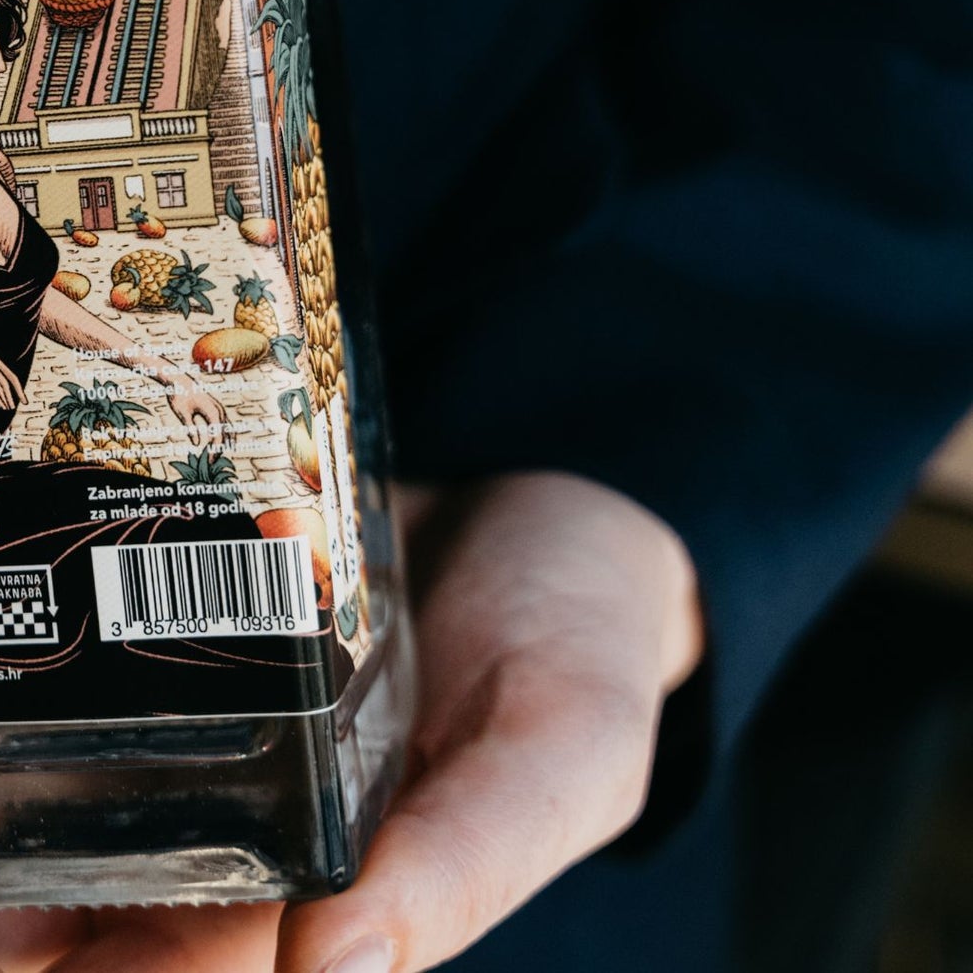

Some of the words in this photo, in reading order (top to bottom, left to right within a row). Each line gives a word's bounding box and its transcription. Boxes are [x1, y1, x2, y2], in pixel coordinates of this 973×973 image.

[203, 358, 234, 374] 147
[77, 385, 126, 402] 10000
[87, 483, 174, 502] Zabranjeno
[177, 480, 280, 496] konzumiran
[89, 509, 108, 521] za
[110, 505, 157, 520] mlađe
[160, 503, 181, 518] od
[186, 501, 205, 516] 18
[111, 620, 123, 637] 3
[142, 615, 209, 636] 857500
[230, 614, 297, 633] 109316
